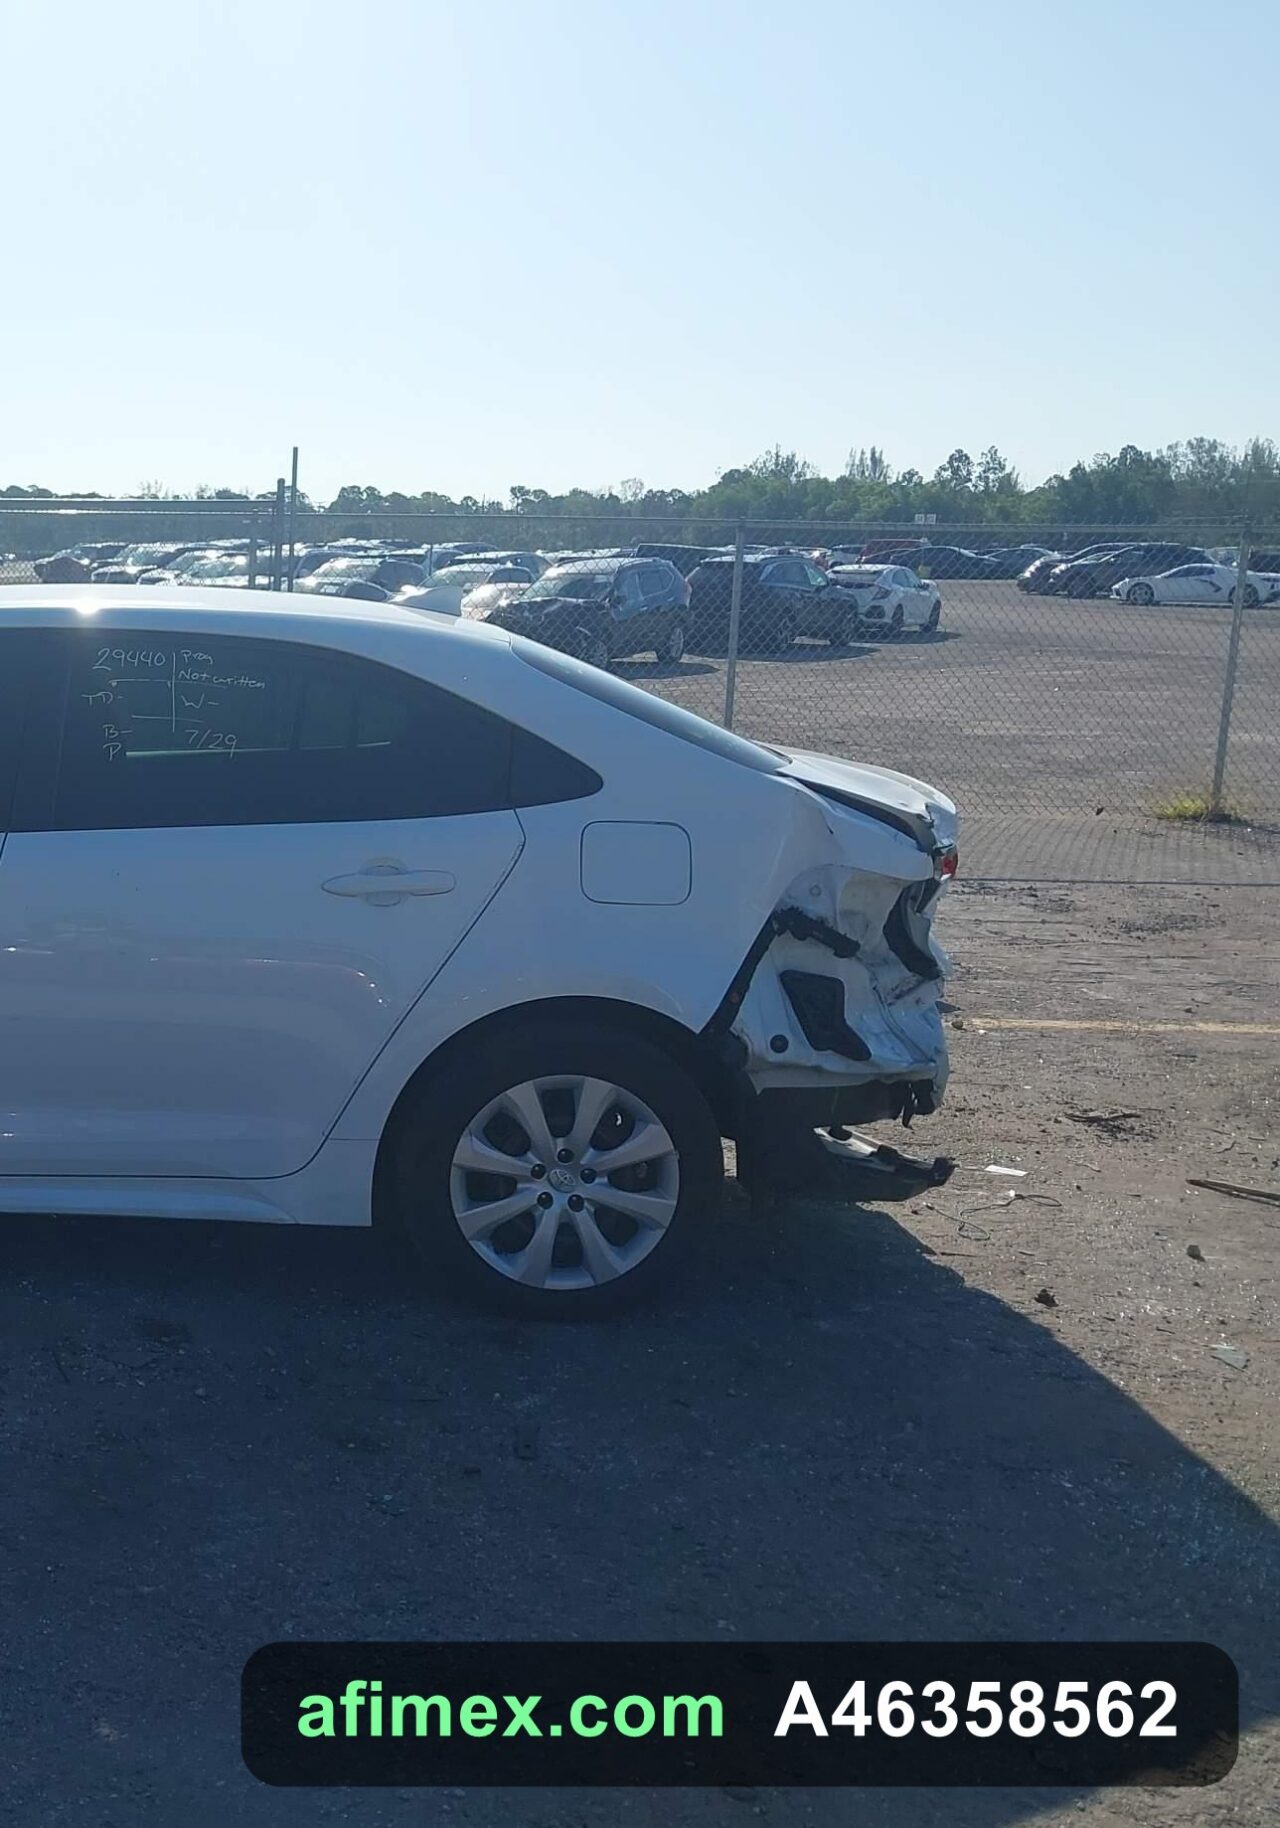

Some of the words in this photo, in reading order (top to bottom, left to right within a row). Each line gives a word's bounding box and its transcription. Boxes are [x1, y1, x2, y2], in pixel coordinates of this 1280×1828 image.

[92, 647, 166, 671] 29440
[178, 667, 211, 681] Not
[185, 729, 238, 759] 7/29
